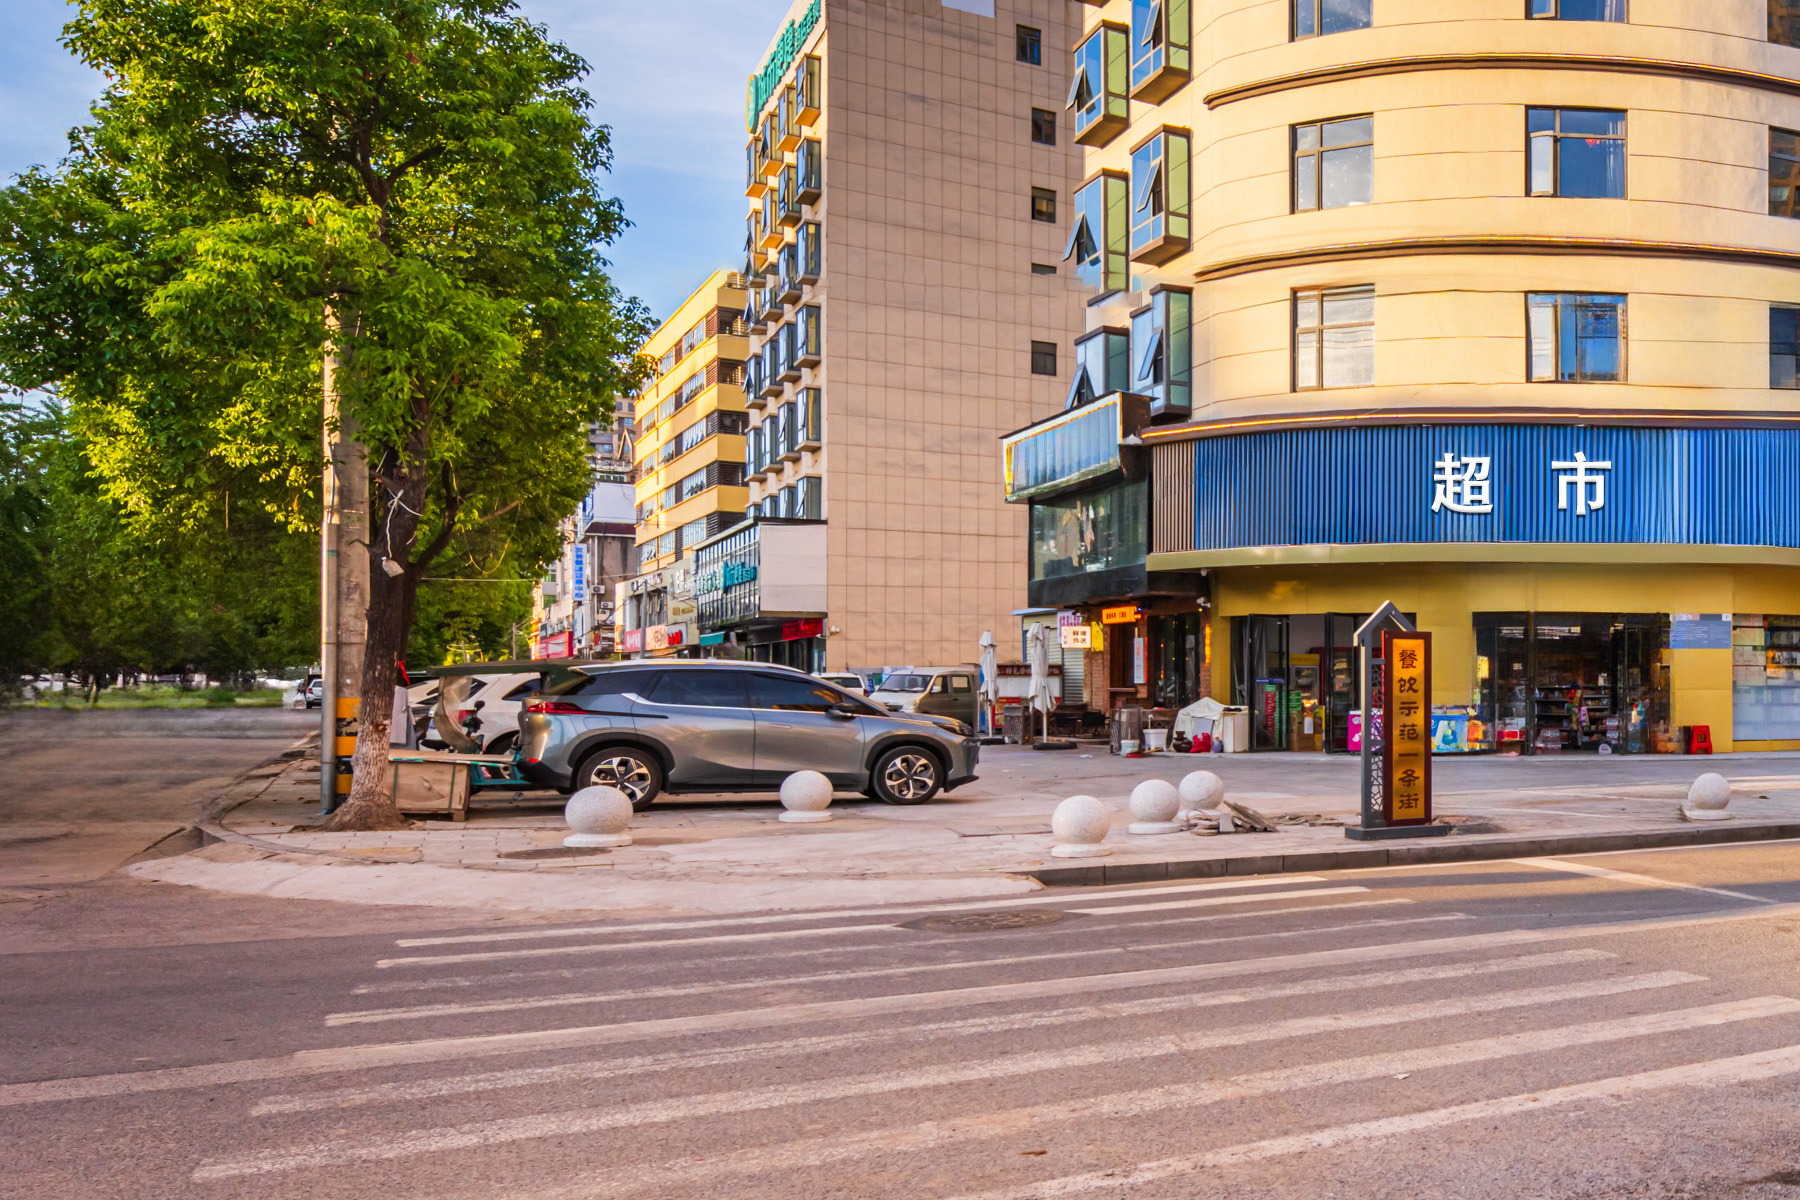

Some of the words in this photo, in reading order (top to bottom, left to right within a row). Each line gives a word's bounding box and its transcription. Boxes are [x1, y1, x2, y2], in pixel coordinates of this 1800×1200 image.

[1431, 452, 1612, 516] 超市
[1398, 649, 1420, 810] 餐饮示范一条街
